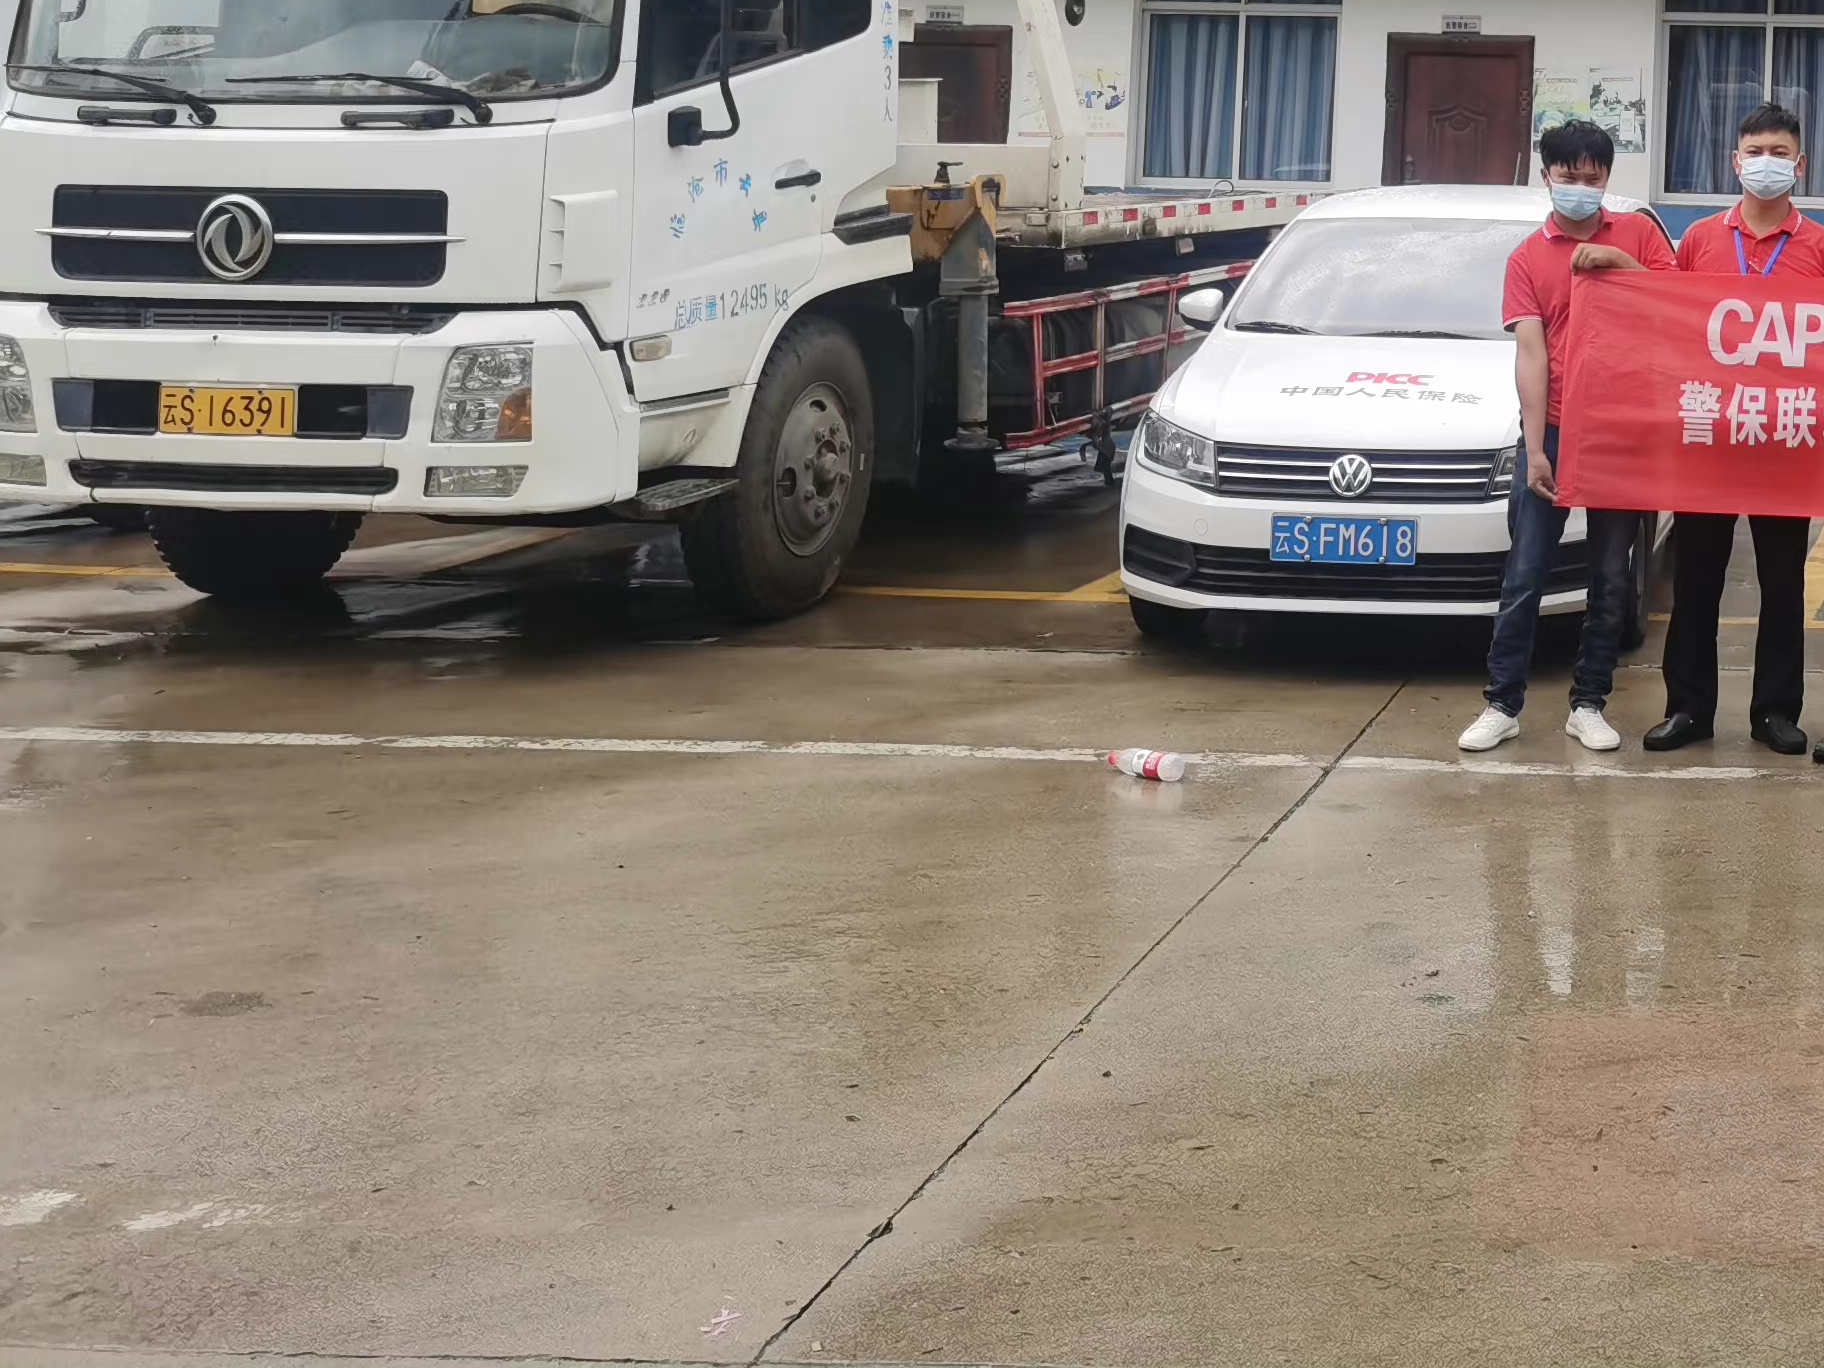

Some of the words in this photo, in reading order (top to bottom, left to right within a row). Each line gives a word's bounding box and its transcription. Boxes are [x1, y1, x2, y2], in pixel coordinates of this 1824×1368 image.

[1345, 371, 1437, 386] PICC
[1280, 385, 1484, 405] 中国人民保险
[162, 393, 286, 428] 云S·16391
[1275, 521, 1412, 558] 云S·FM618
